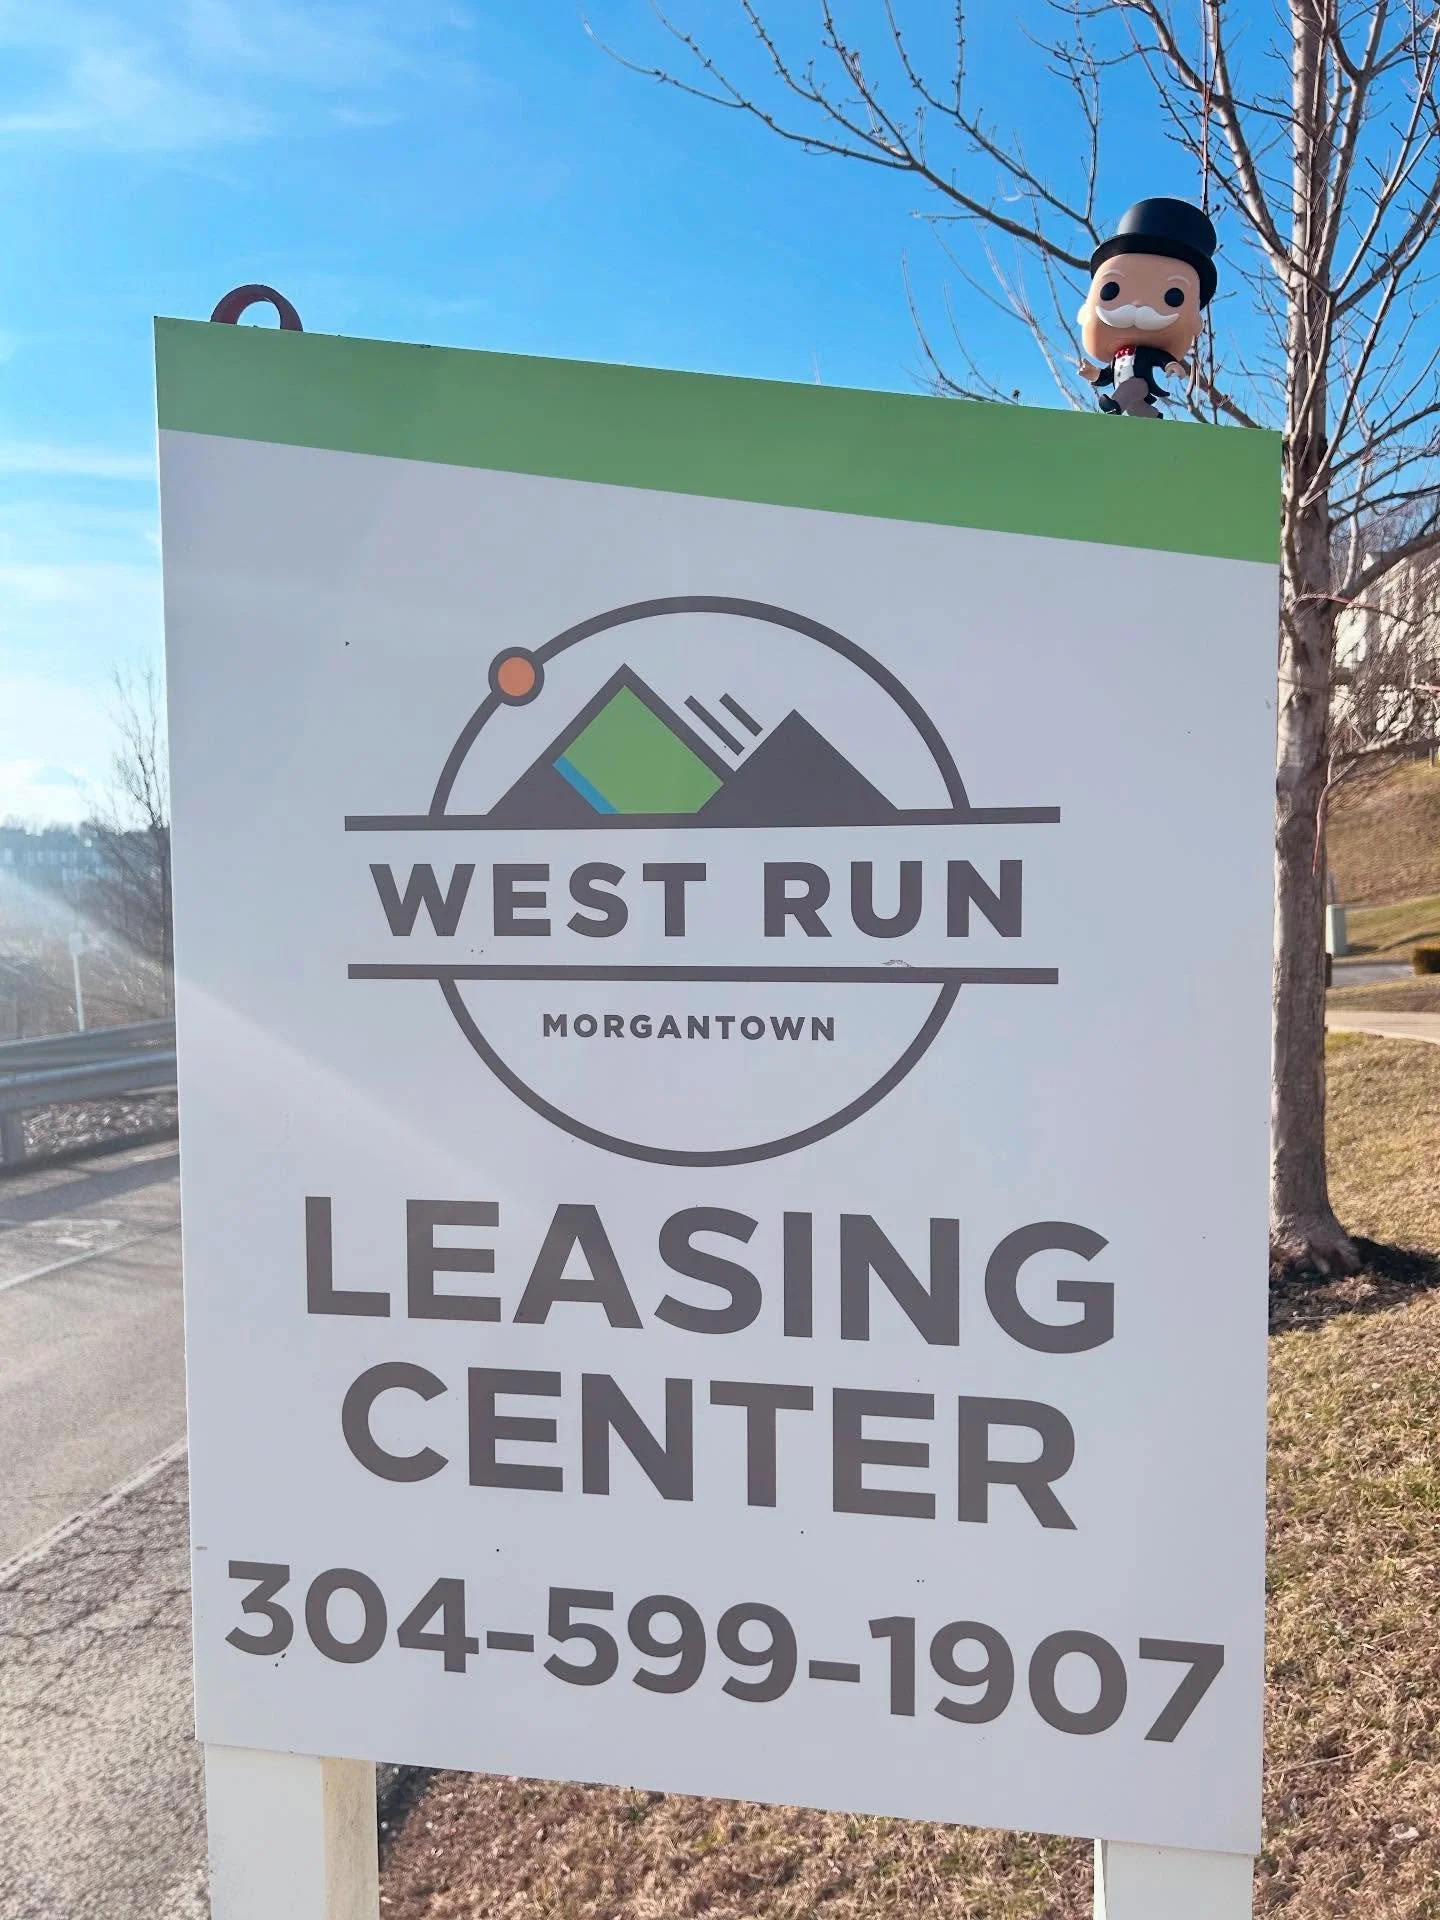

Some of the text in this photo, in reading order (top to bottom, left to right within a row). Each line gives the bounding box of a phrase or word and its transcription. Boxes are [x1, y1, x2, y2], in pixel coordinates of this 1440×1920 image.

[369, 860, 1023, 938] WEST RUN
[543, 1013, 836, 1042] MORGANTOWN
[305, 1196, 1115, 1355] LEASING
[342, 1361, 1078, 1531] CENTER
[225, 1559, 1225, 1743] 304-599-1907
